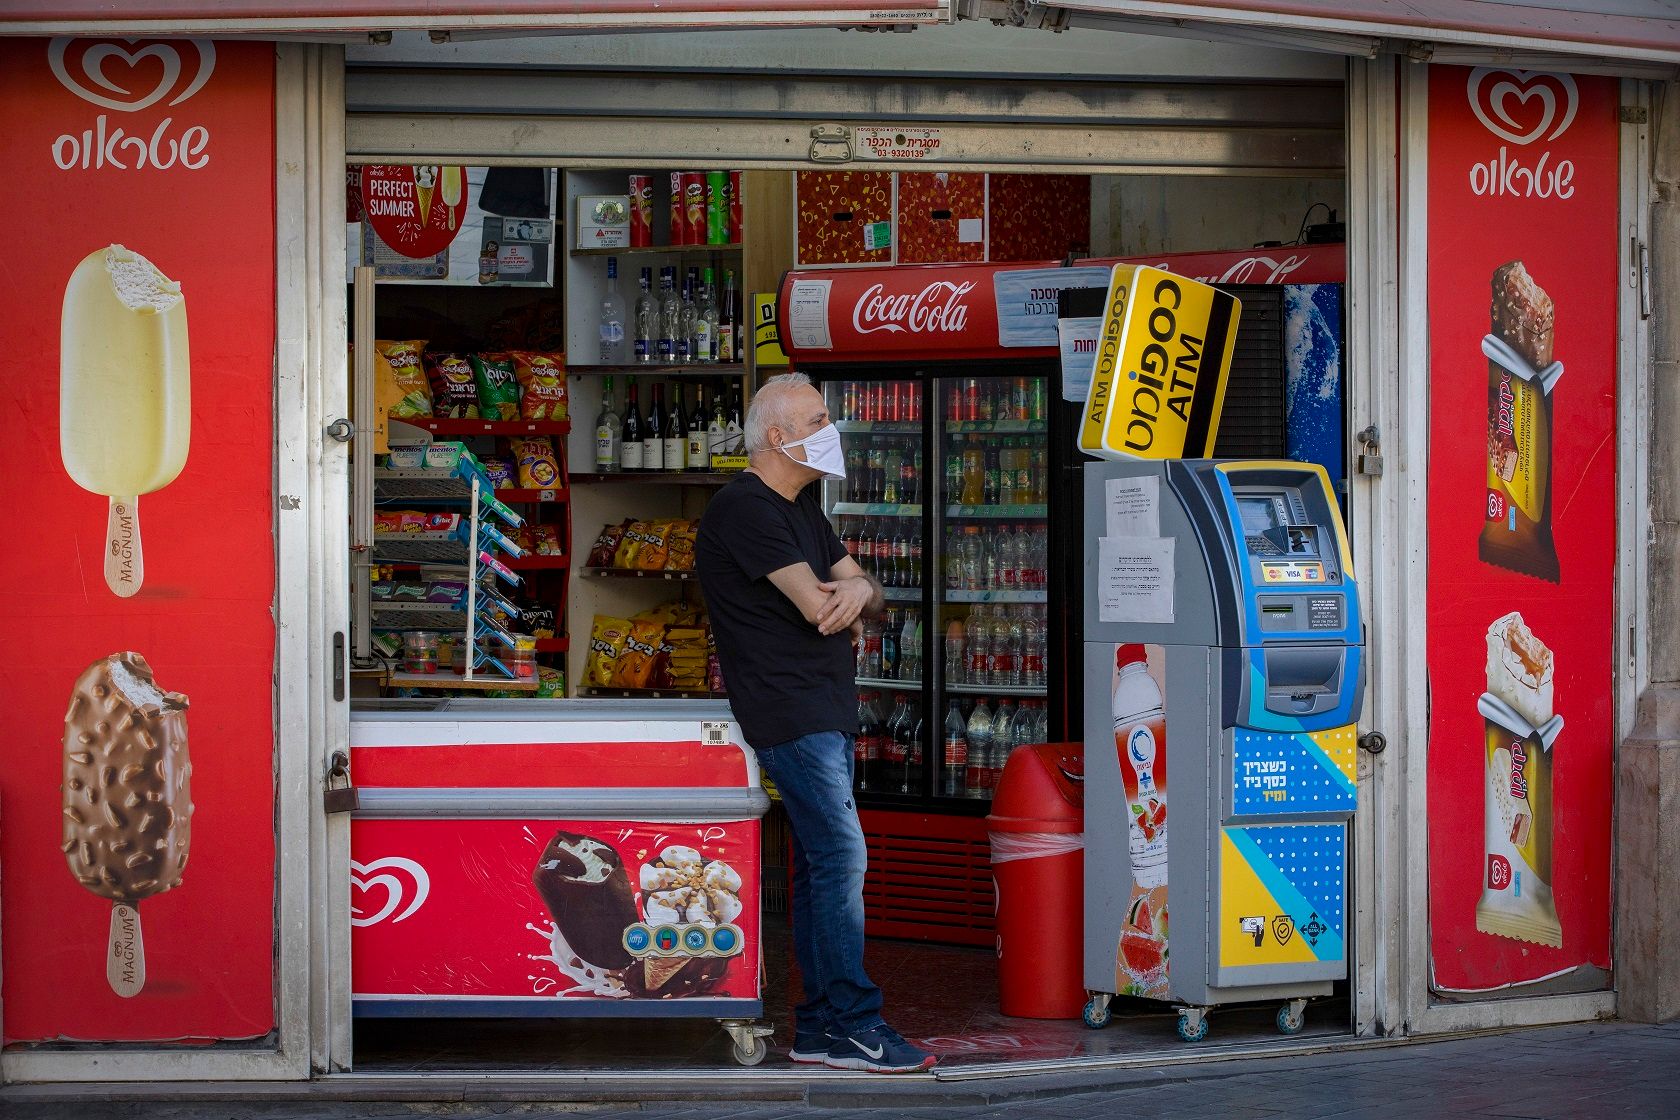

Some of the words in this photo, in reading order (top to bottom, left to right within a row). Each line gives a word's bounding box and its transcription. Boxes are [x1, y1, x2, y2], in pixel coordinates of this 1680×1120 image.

[52, 114, 210, 170] שטראוס
[866, 138, 892, 147] הכפר
[906, 138, 940, 148] מסגרית
[877, 149, 924, 158] 03-9320139
[1469, 146, 1575, 199] שטראוס
[370, 180, 414, 198] PERFECT
[370, 199, 415, 217] SUMMER
[853, 280, 978, 334] Coca-Cola
[1166, 333, 1203, 423] ATM
[1090, 381, 1109, 424] ATM
[121, 516, 132, 583] MAGNUM
[1285, 570, 1301, 578] VISA
[1243, 760, 1287, 775] כשצריך
[1243, 776, 1262, 788] ביד
[1263, 775, 1287, 789] כסף
[1262, 790, 1287, 802] ומיד
[123, 918, 134, 984] MAGNUM
